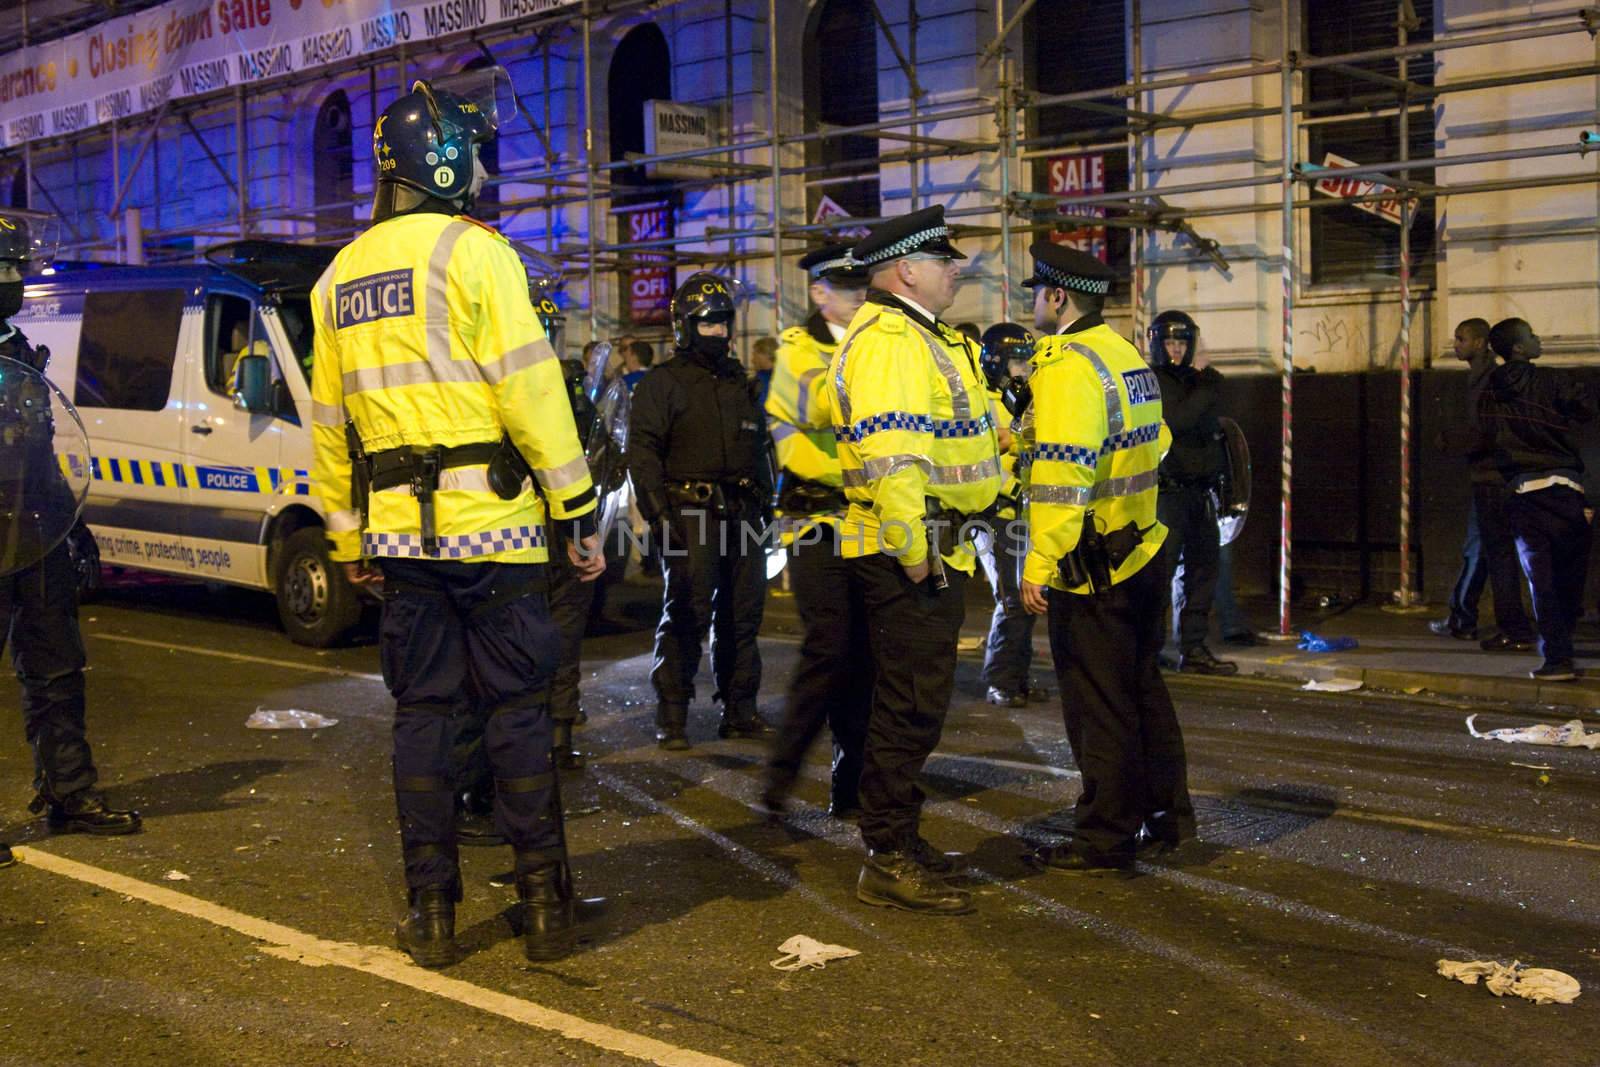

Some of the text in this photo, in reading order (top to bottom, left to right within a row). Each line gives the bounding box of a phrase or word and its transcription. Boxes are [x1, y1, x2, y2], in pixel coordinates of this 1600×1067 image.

[89, 24, 158, 78] Closing
[165, 9, 213, 54] down
[218, 0, 272, 34] sale
[52, 102, 88, 133] MASSIMO
[140, 74, 173, 111] MASSIM
[180, 58, 230, 94] MASSIMO
[239, 44, 292, 81] MASSIMO
[302, 27, 352, 66] MASSIMO
[361, 10, 412, 48] MASSIMO
[424, 0, 487, 36] MASSIMO
[659, 111, 706, 136] MASSIMO
[440, 172, 449, 184] D
[1052, 156, 1103, 192] SALE
[631, 209, 667, 241] SALE
[340, 281, 411, 325] POLICE
[207, 473, 249, 489] POLICE
[144, 539, 195, 569] protecting
[196, 545, 231, 572] people
